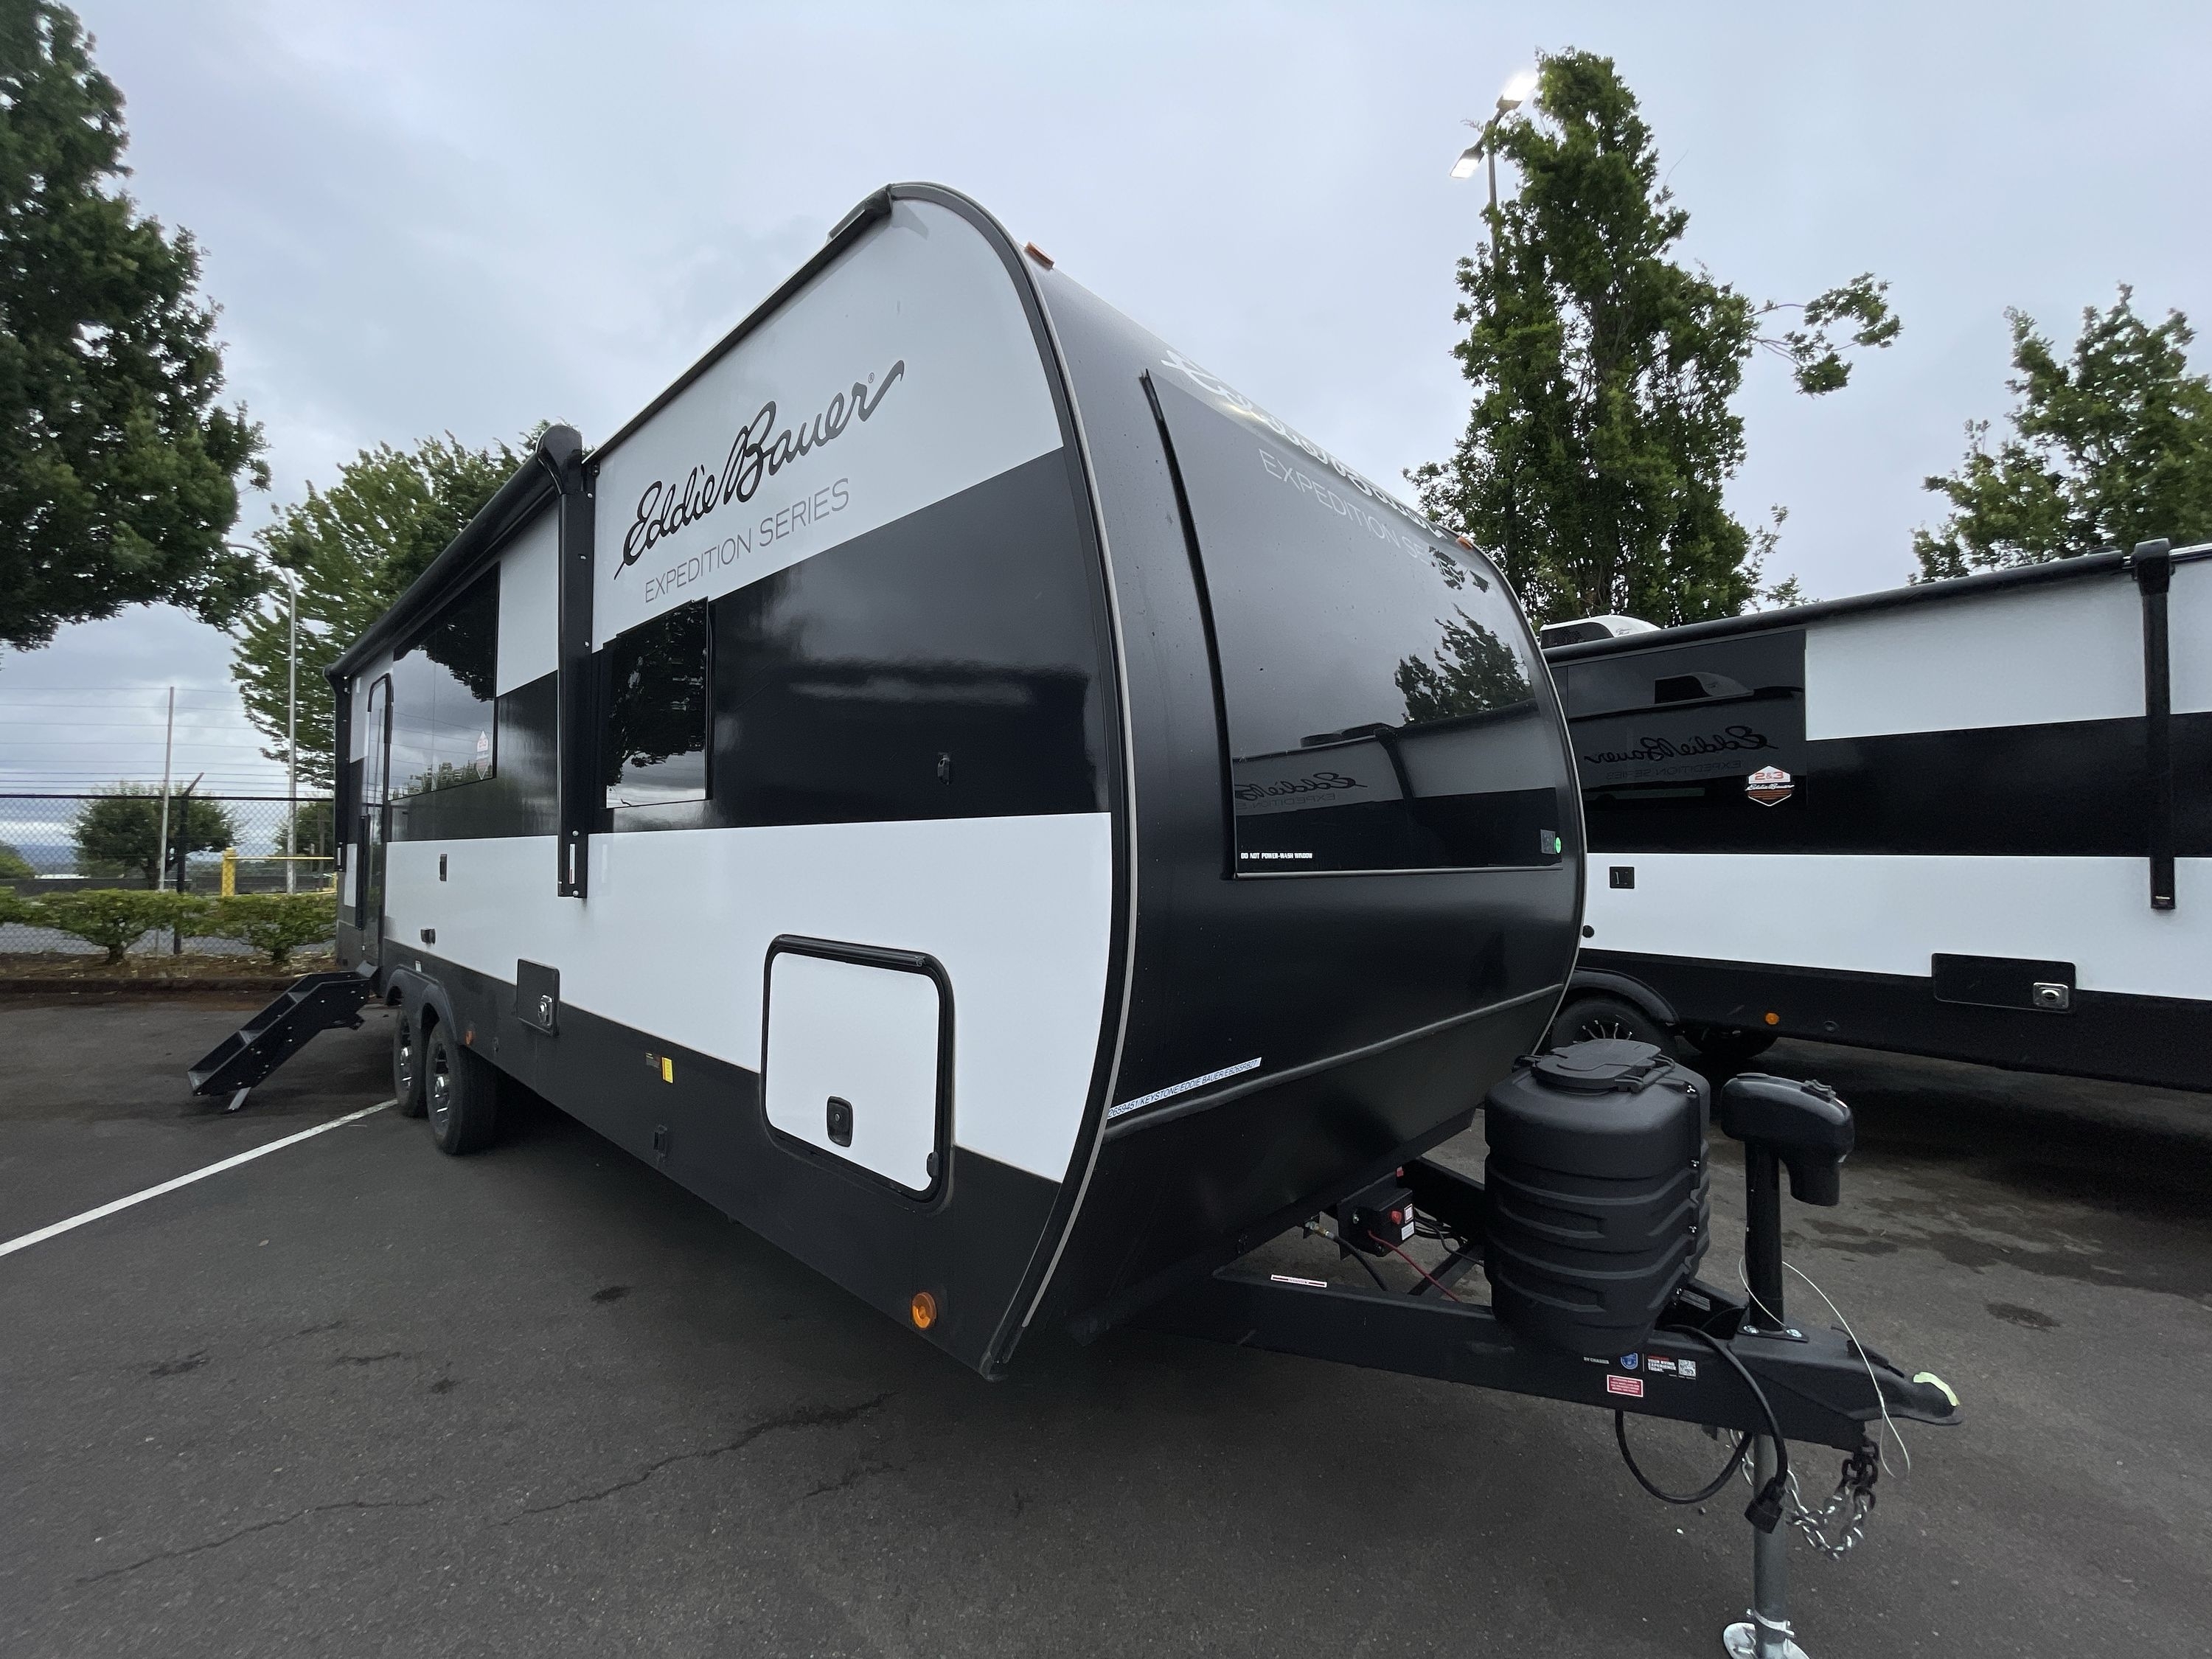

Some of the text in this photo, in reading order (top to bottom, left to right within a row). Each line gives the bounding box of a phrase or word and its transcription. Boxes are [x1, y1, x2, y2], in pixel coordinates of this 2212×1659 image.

[613, 359, 905, 580] Eddie Bauer
[1258, 448, 1402, 549] EXPEDITION
[644, 478, 849, 603] EXPEDITION SERIES
[1138, 1085, 1180, 1105] KEYSTONE
[1180, 1078, 1201, 1091] EDDIE
[1202, 1071, 1224, 1084] BAUER
